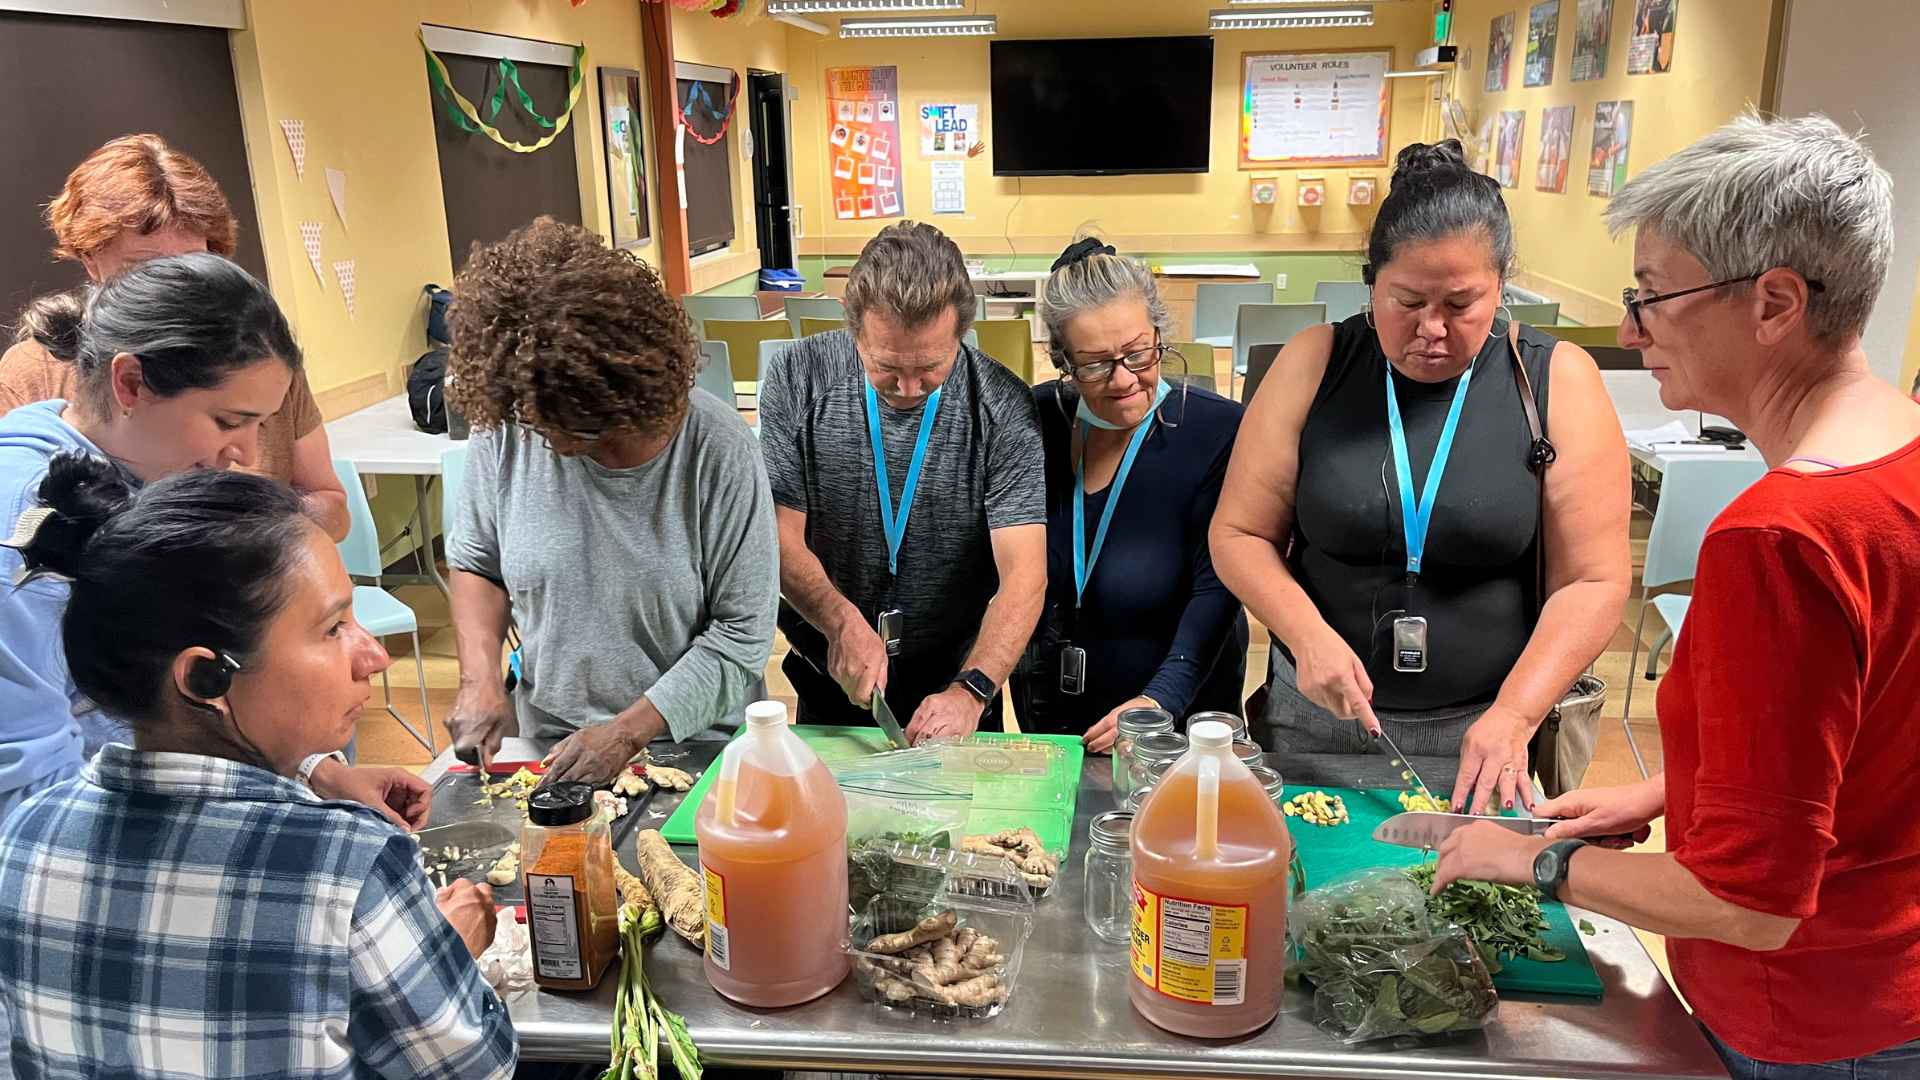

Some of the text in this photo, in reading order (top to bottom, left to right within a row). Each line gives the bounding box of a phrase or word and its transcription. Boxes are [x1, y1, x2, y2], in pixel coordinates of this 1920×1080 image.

[1269, 61, 1349, 71] VOLUNTEER ROLES
[830, 68, 892, 82] VOLUNTEER OF
[838, 80, 887, 92] THE MONTH
[921, 105, 956, 119] SHIFT
[935, 119, 967, 132] LEAD
[1164, 899, 1192, 909] Nutrition
[1193, 903, 1211, 912] Facts
[1164, 919, 1189, 929] Calories
[1204, 924, 1210, 932] 0
